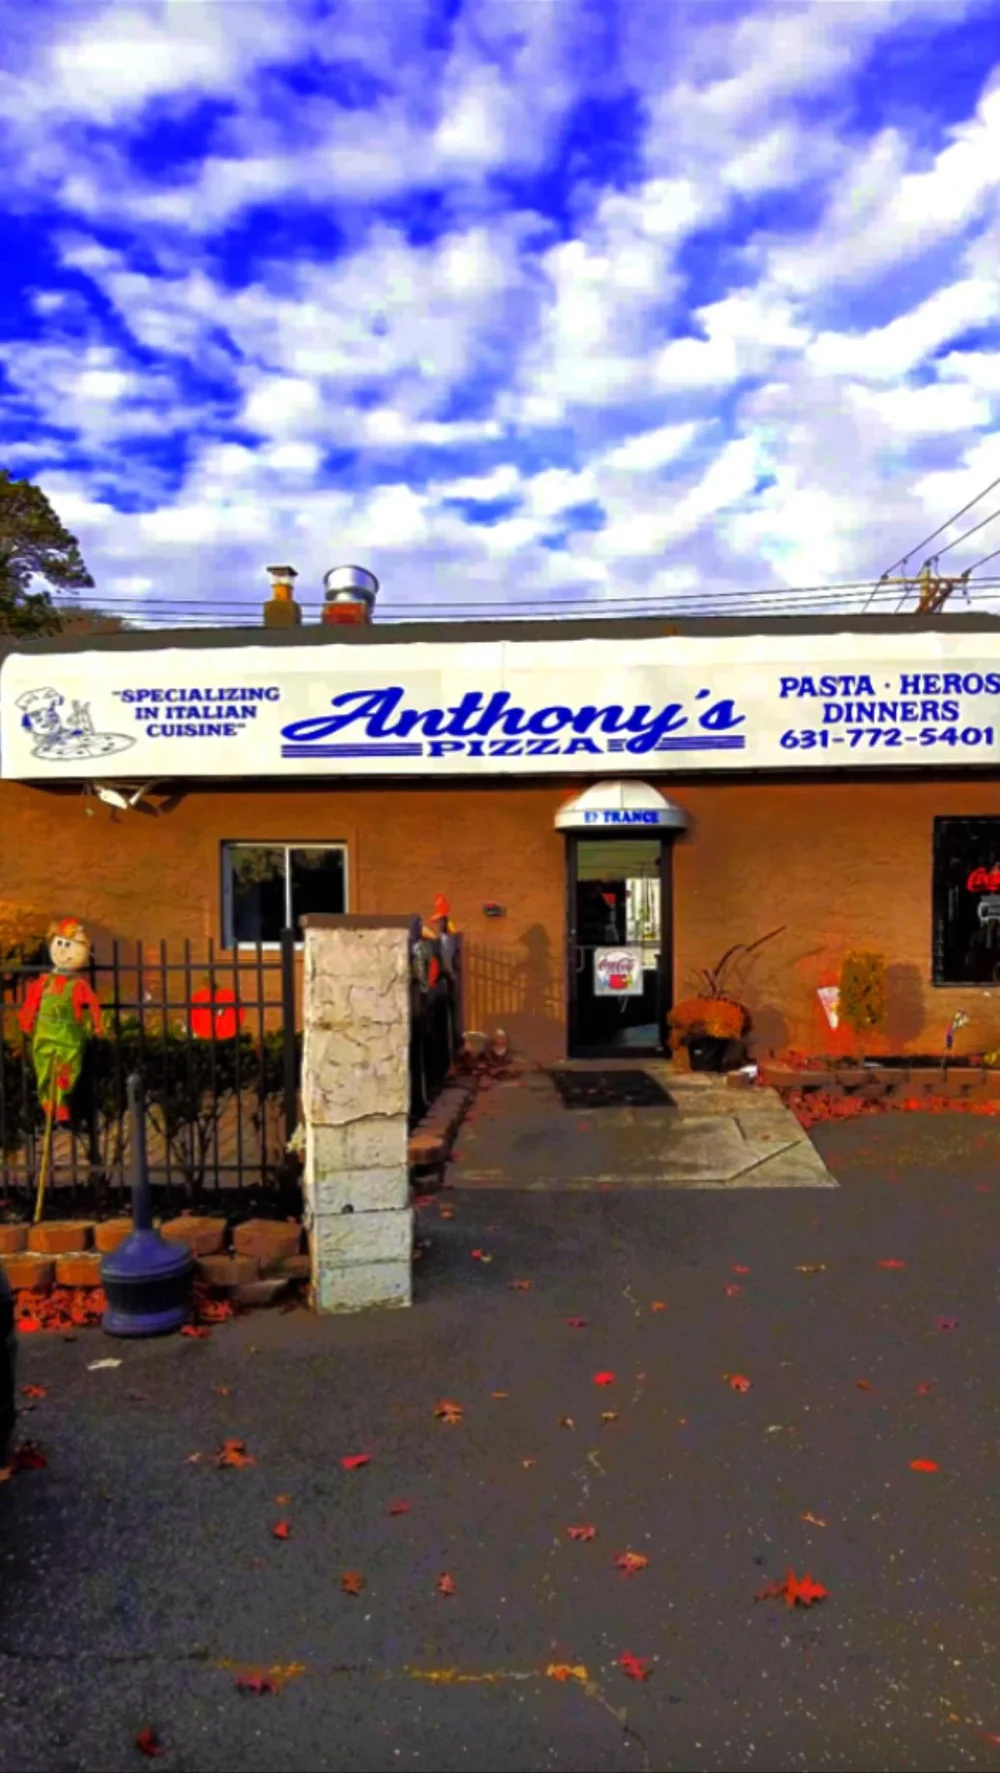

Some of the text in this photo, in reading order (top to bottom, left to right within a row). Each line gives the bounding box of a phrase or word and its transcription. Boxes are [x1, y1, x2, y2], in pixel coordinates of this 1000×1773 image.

[780, 672, 1000, 698] PASTA HEROS
[135, 705, 257, 719] IN ITALIAN
[281, 686, 745, 754] Anthony's
[823, 700, 959, 723] DINNERS
[427, 737, 604, 757] PIZZA
[780, 726, 994, 749] 631-772-5401
